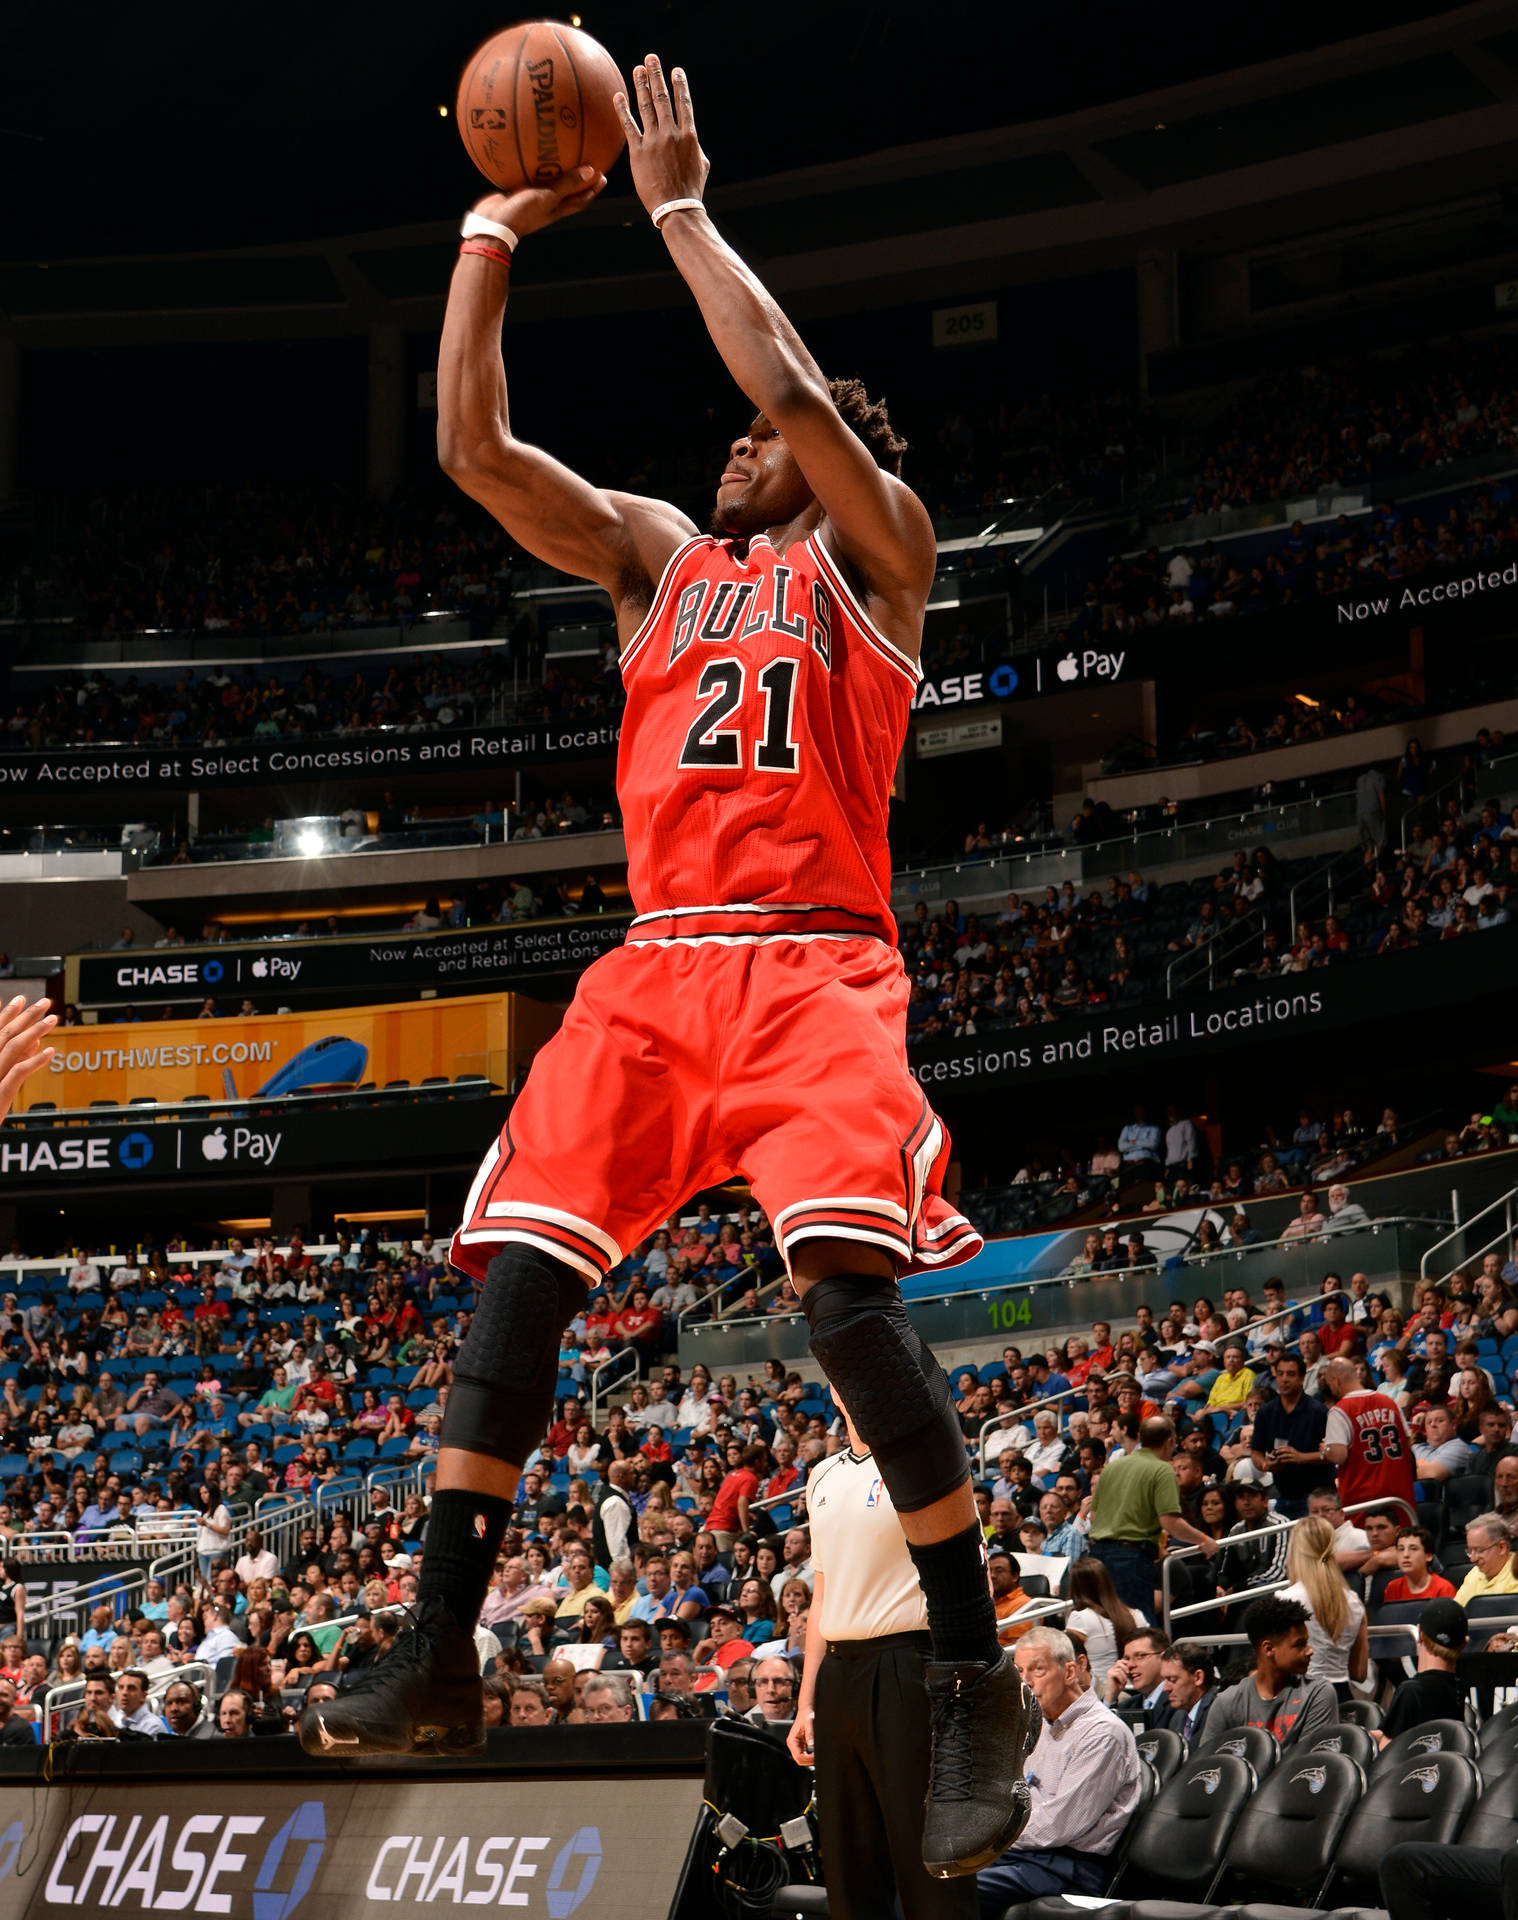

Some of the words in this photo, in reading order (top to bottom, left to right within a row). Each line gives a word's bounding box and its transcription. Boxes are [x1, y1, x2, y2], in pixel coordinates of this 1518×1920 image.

[525, 58, 563, 178] SPALDING
[945, 312, 985, 335] 205
[1337, 597, 1389, 623] Now
[1399, 562, 1517, 609] Accepted
[666, 564, 832, 673] BULLS
[911, 673, 984, 710] ASE
[1082, 650, 1126, 681] Pay
[677, 656, 801, 775] 21
[37, 760, 150, 782] Accepted
[159, 761, 181, 778] at
[191, 756, 259, 777] Select
[268, 747, 411, 771] Concessions
[419, 740, 461, 760] and
[471, 734, 535, 756] Retail
[370, 948, 407, 963] Now
[412, 941, 489, 961] Accepted
[493, 938, 509, 953] at
[514, 932, 564, 950] Select
[437, 957, 468, 973] and
[472, 950, 518, 968] Retail
[522, 944, 601, 964] Locations
[116, 964, 199, 987] CHASE
[270, 957, 302, 981] Pay
[1042, 1032, 1092, 1064] and
[1103, 1015, 1178, 1053] Retail
[1190, 991, 1323, 1038] Locations
[48, 1040, 272, 1074] SOUTHWEST.COM
[233, 1127, 282, 1166] Pay
[987, 1297, 1033, 1329] 104
[1355, 1408, 1396, 1428] PIPPEN
[1360, 1424, 1403, 1464] 33
[44, 1814, 267, 1914] CHASE
[366, 1835, 551, 1906] CHASE
